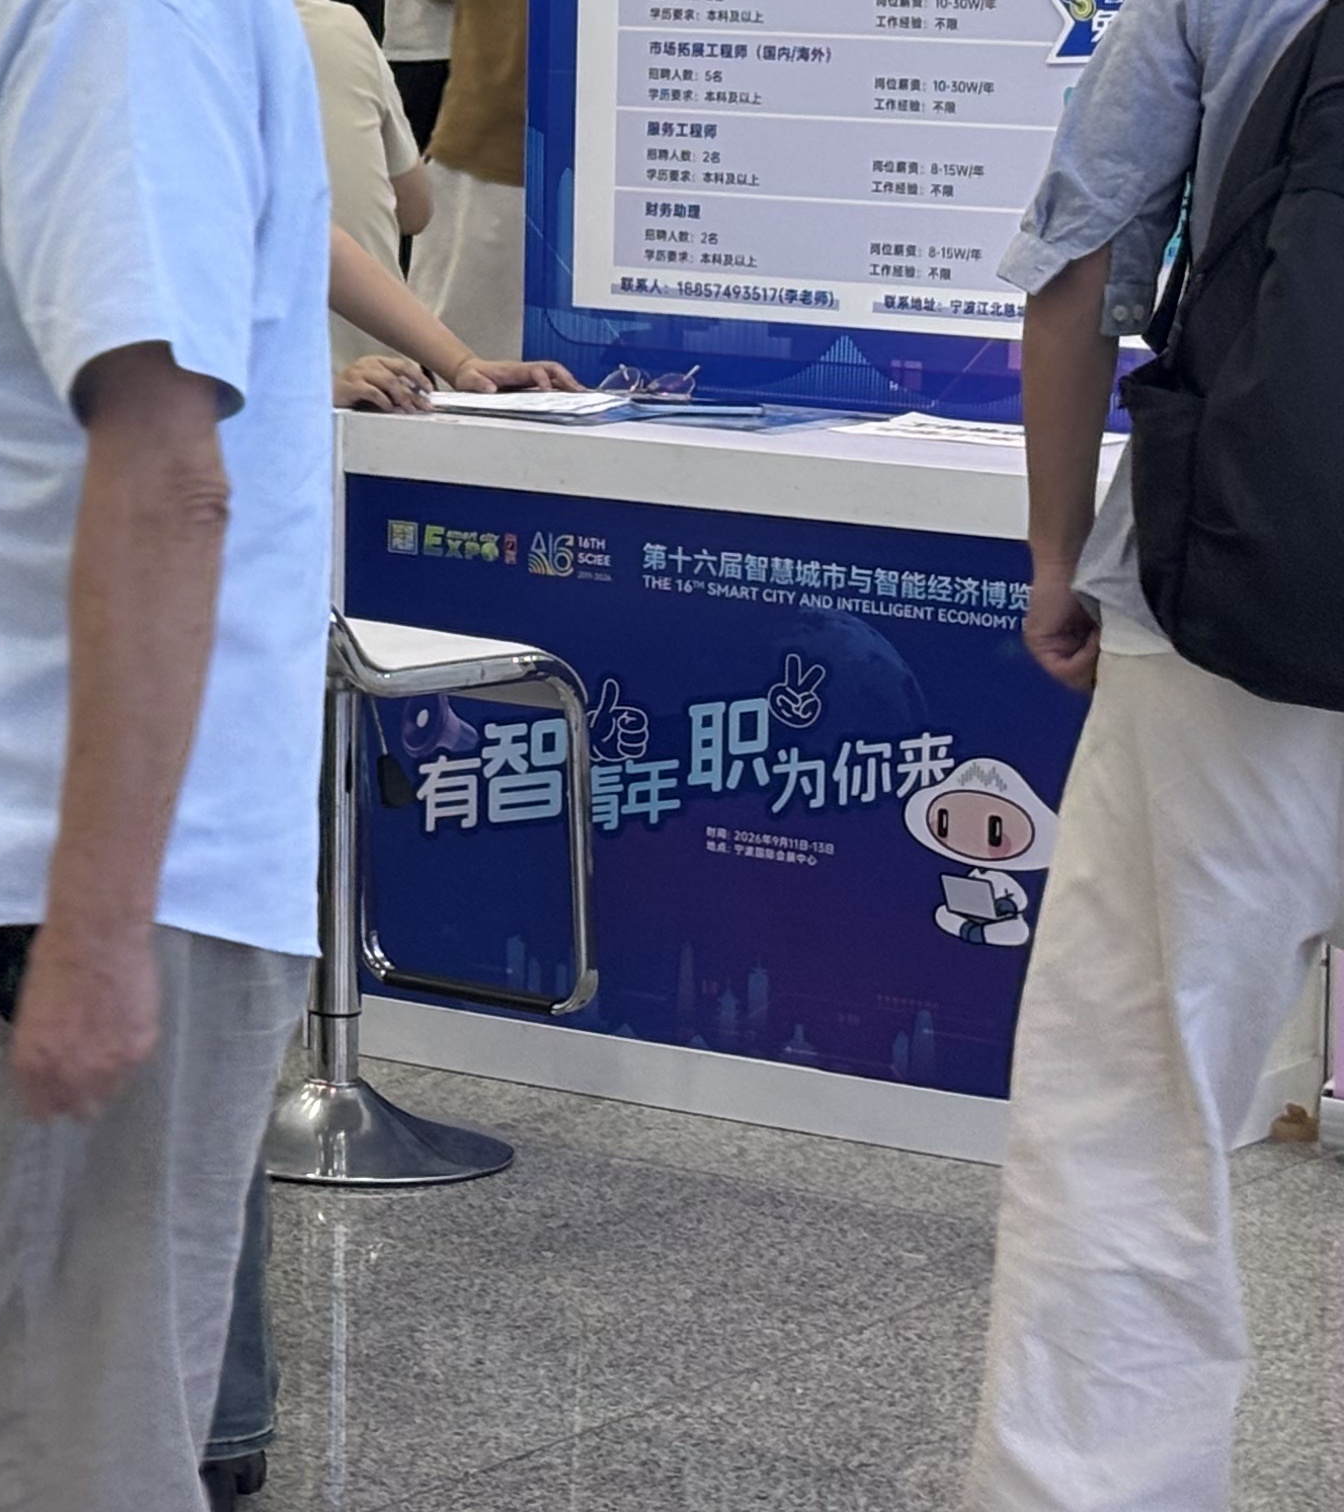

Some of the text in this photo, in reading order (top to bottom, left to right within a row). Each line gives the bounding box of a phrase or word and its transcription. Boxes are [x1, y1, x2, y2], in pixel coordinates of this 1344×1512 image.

[649, 40, 832, 64] 市场拓展工程师（国内/海外）
[646, 120, 718, 139] 服务工程师
[644, 201, 702, 220] 财务助理
[577, 535, 607, 551] 16TH
[642, 542, 1034, 612] 第十六届智慧城市与智能经济博览
[642, 574, 673, 592] THE
[707, 581, 759, 602] SMART
[761, 587, 797, 607] CITY
[799, 592, 834, 611] AND
[836, 596, 934, 622] INTELLIGENT
[937, 608, 1018, 631] ECONOMY
